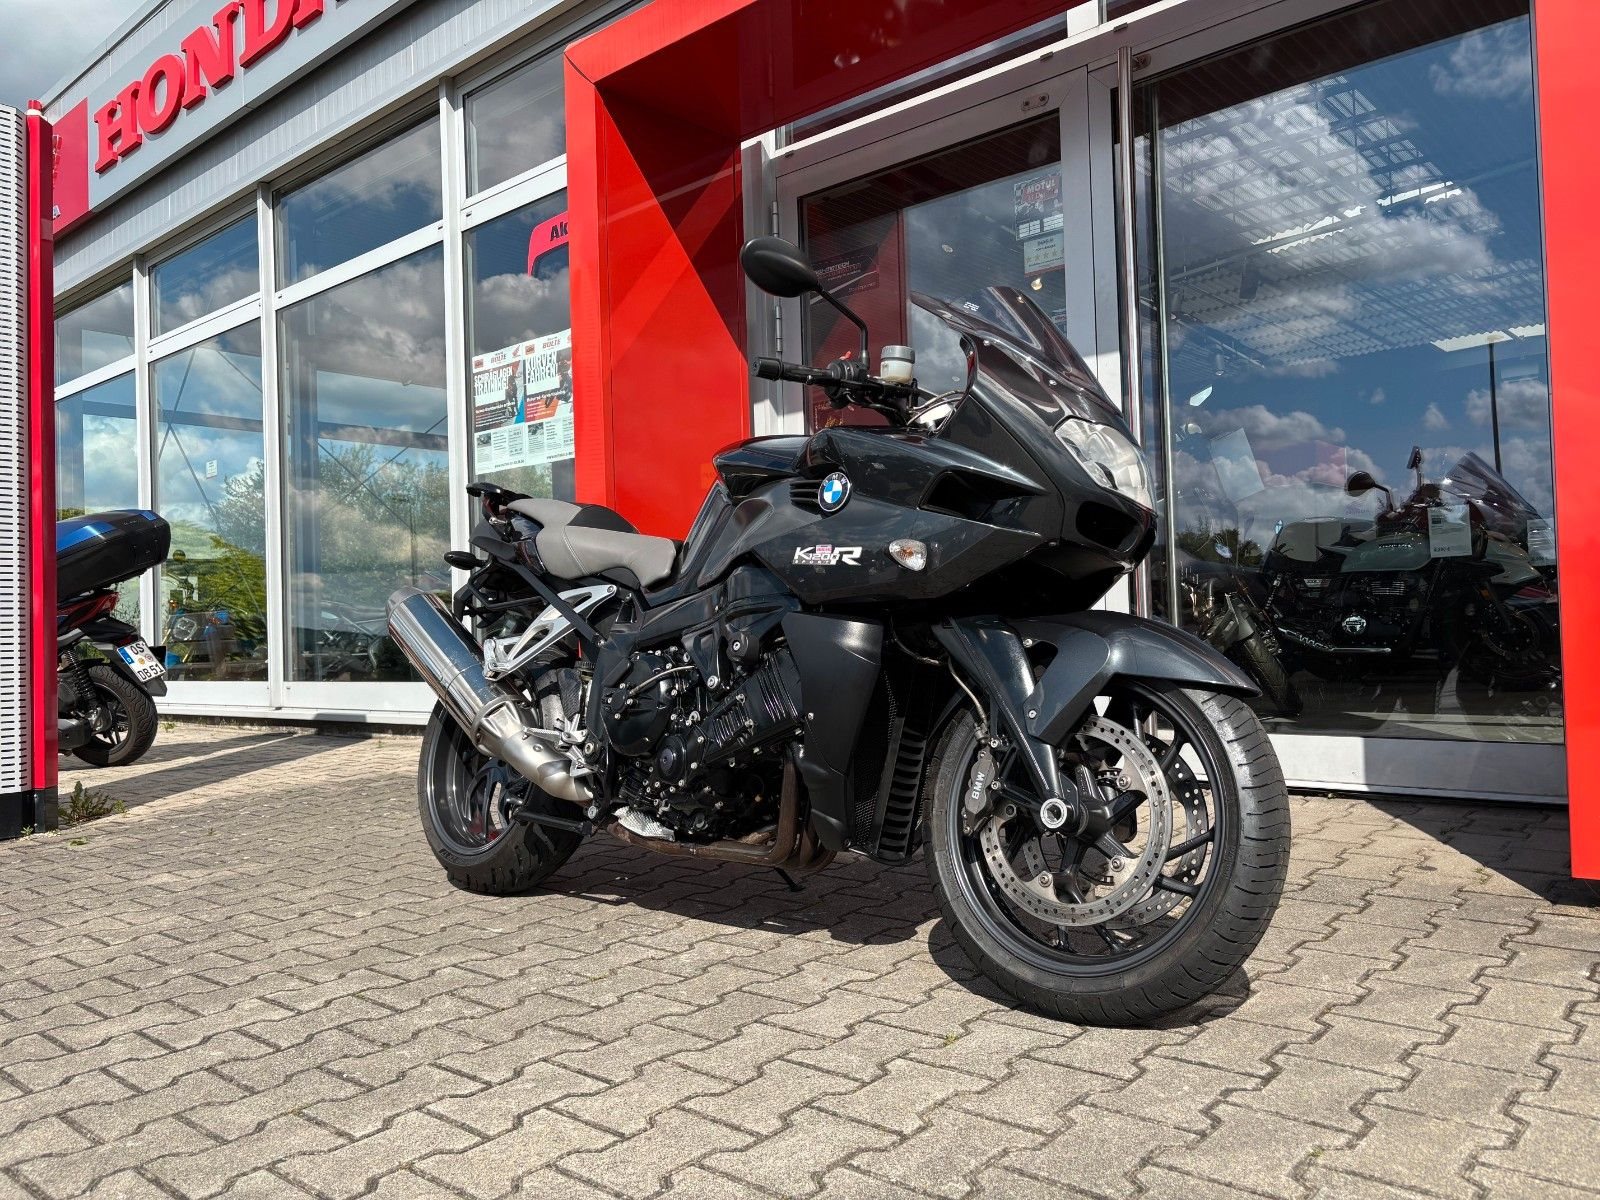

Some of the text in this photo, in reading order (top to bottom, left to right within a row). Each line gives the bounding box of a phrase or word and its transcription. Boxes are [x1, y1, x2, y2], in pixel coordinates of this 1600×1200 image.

[94, 0, 324, 173] HOND
[526, 351, 558, 372] KURVEN
[130, 643, 145, 656] OS
[138, 664, 164, 681] DB 51
[971, 771, 985, 800] BMW
